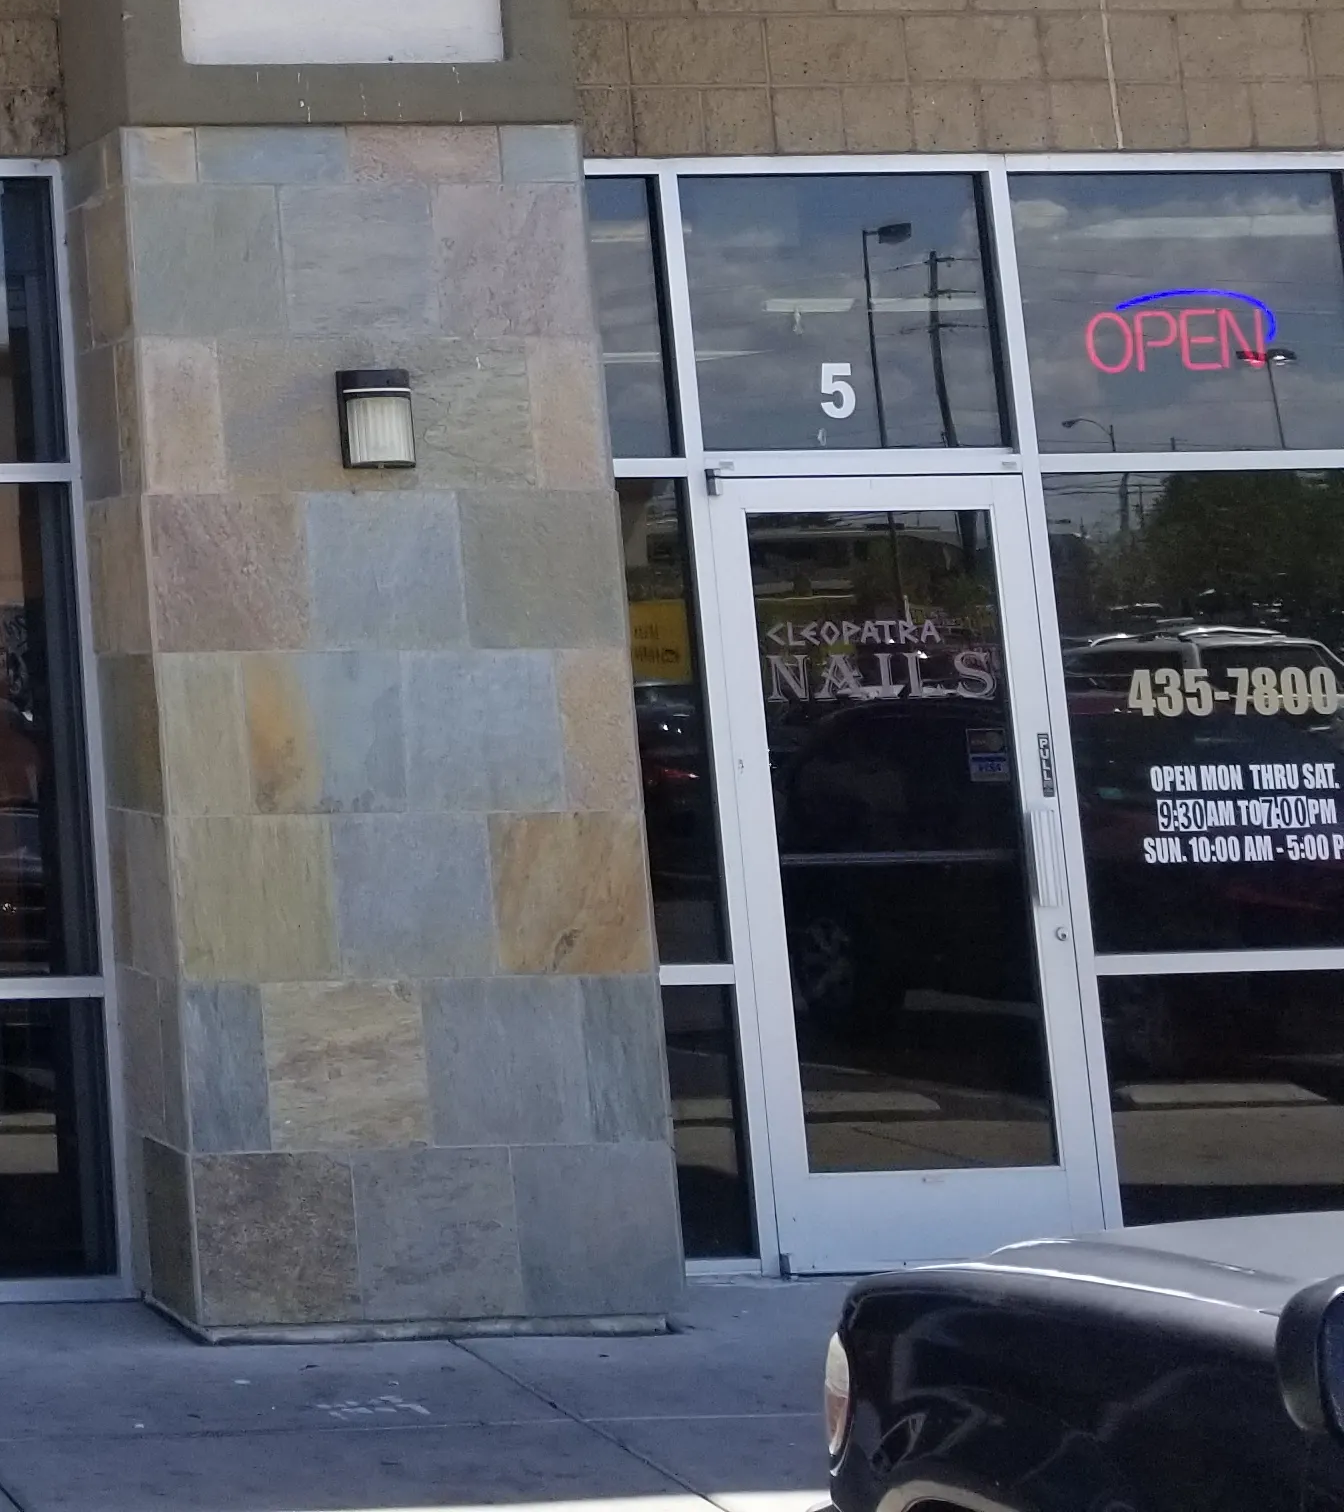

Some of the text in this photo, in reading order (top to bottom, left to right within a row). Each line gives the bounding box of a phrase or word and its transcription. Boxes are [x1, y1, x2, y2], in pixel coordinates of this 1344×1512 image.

[1084, 307, 1272, 374] OPEN
[820, 362, 857, 420] 5
[766, 619, 942, 647] CLEOPATRA
[766, 651, 997, 702] NAILS
[1127, 666, 1339, 717] 435-7800
[1039, 738, 1052, 781] PULL
[1150, 762, 1341, 793] OPEN MON THRU SAT.
[1143, 837, 1188, 864] SUN.
[1189, 836, 1241, 863] 10:00
[1244, 835, 1274, 862] AM
[1286, 834, 1330, 861] 5:00
